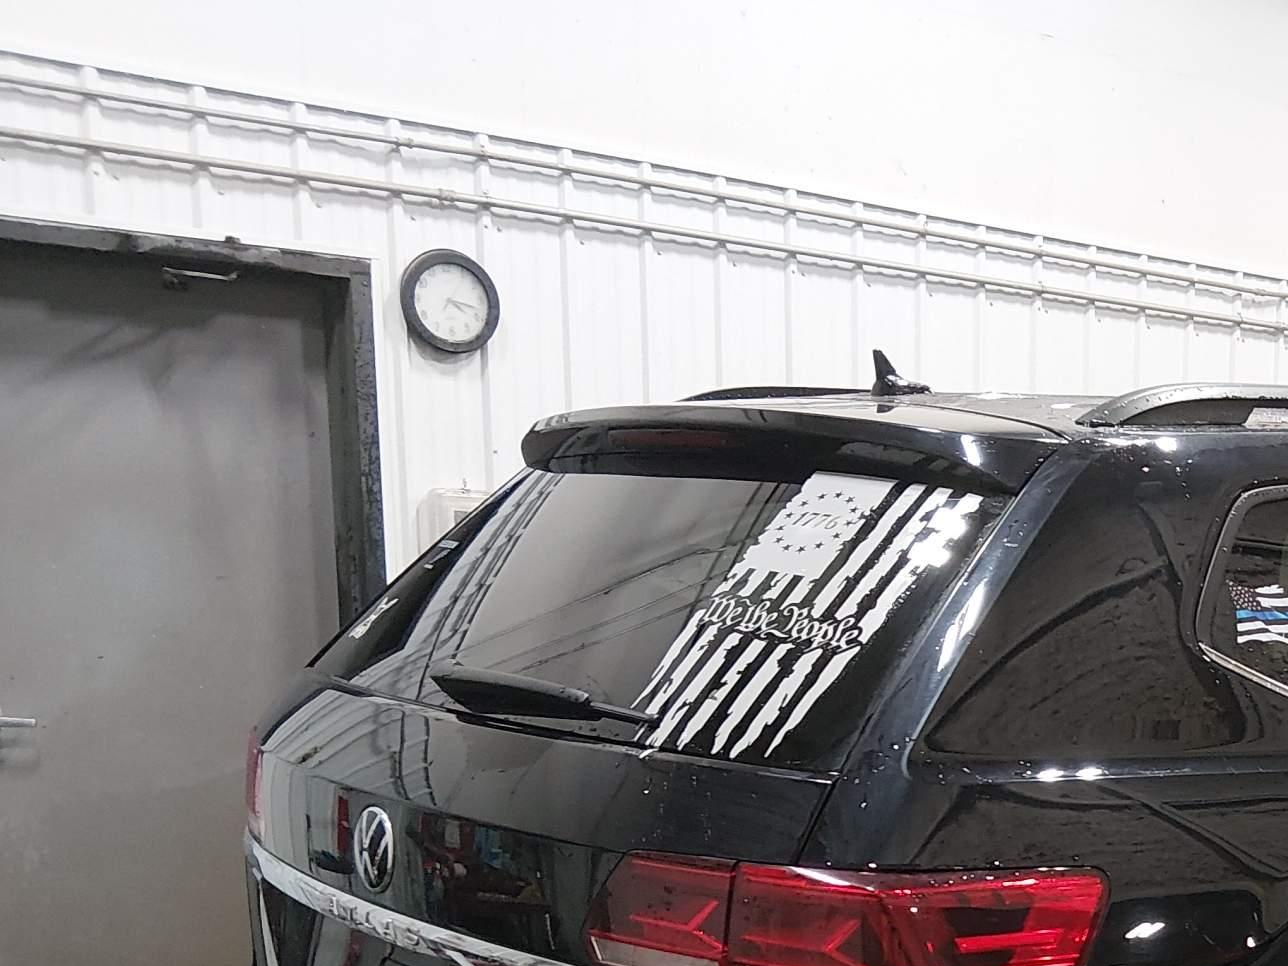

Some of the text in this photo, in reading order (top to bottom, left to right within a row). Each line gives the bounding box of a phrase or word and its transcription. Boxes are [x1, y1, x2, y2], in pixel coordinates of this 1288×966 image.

[792, 511, 841, 530] 1776
[699, 594, 860, 652] We the People
